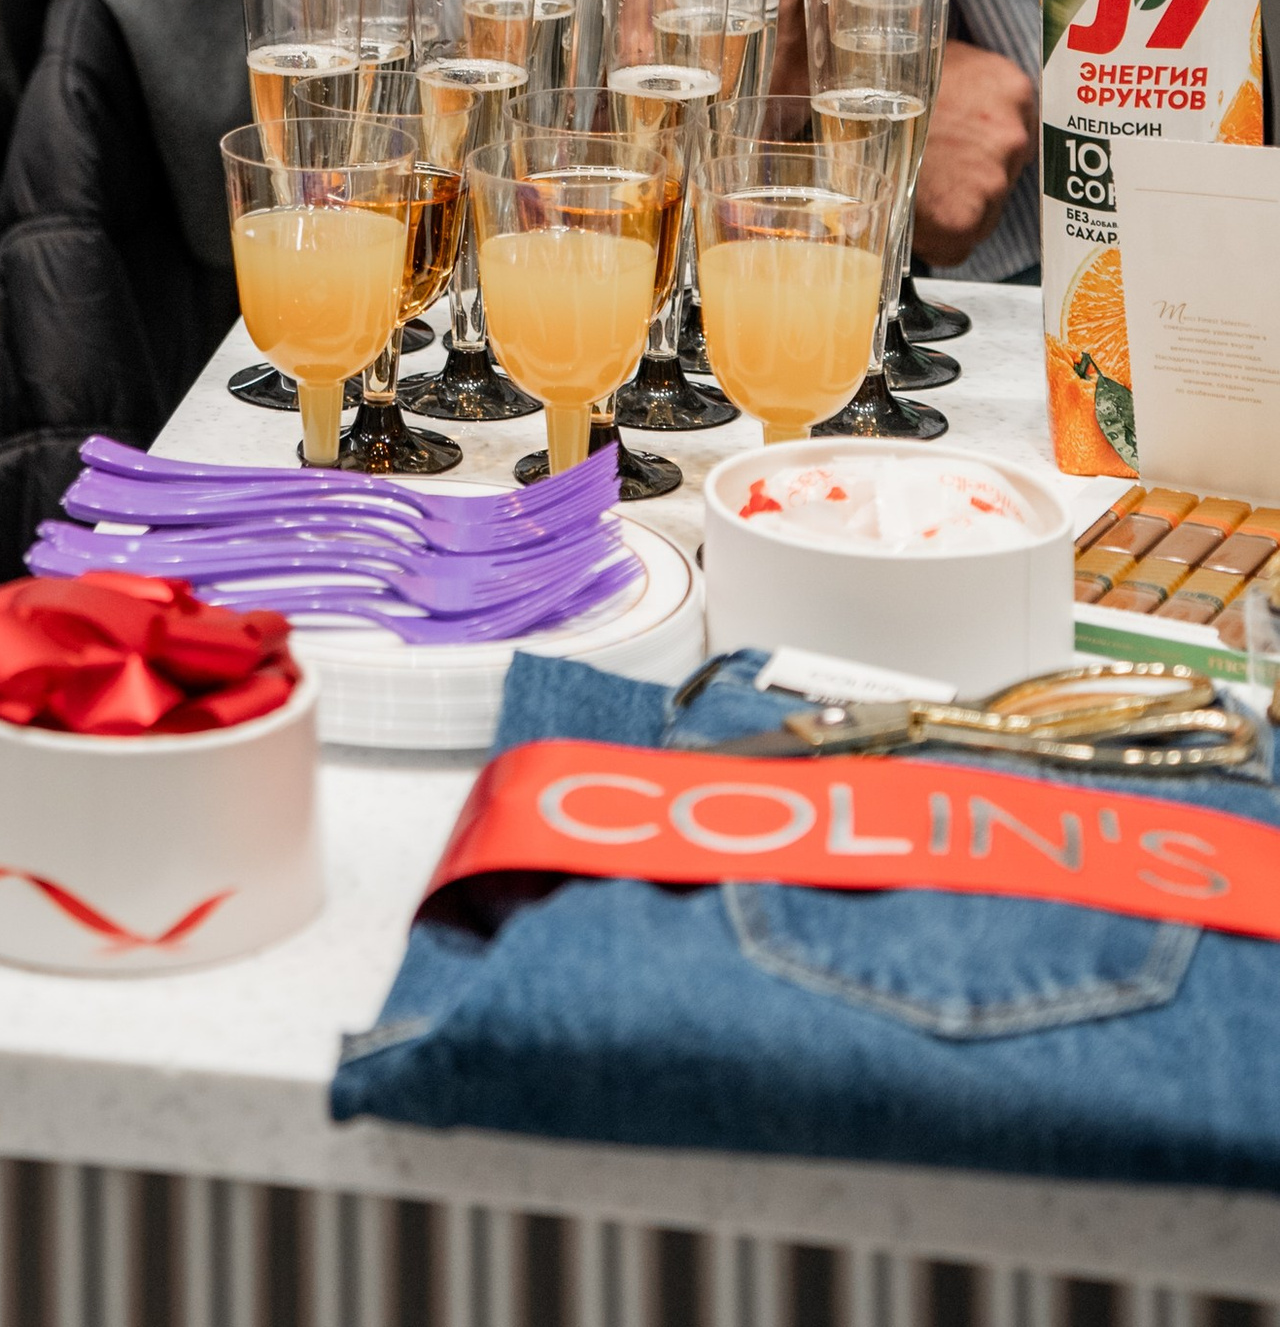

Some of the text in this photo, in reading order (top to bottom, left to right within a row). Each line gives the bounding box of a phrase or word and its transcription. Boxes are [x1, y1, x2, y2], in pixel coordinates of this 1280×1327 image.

[1079, 61, 1208, 88] ЭНЕРГИЯ
[1076, 84, 1207, 111] ФРУКТОВ
[1066, 115, 1162, 137] АПЕЛЬСИН
[1065, 139, 1115, 177] 10
[1066, 207, 1119, 229] БЕЗ ДОБАВ
[1066, 223, 1121, 245] САХАР
[537, 772, 1232, 900] COLIN'S
